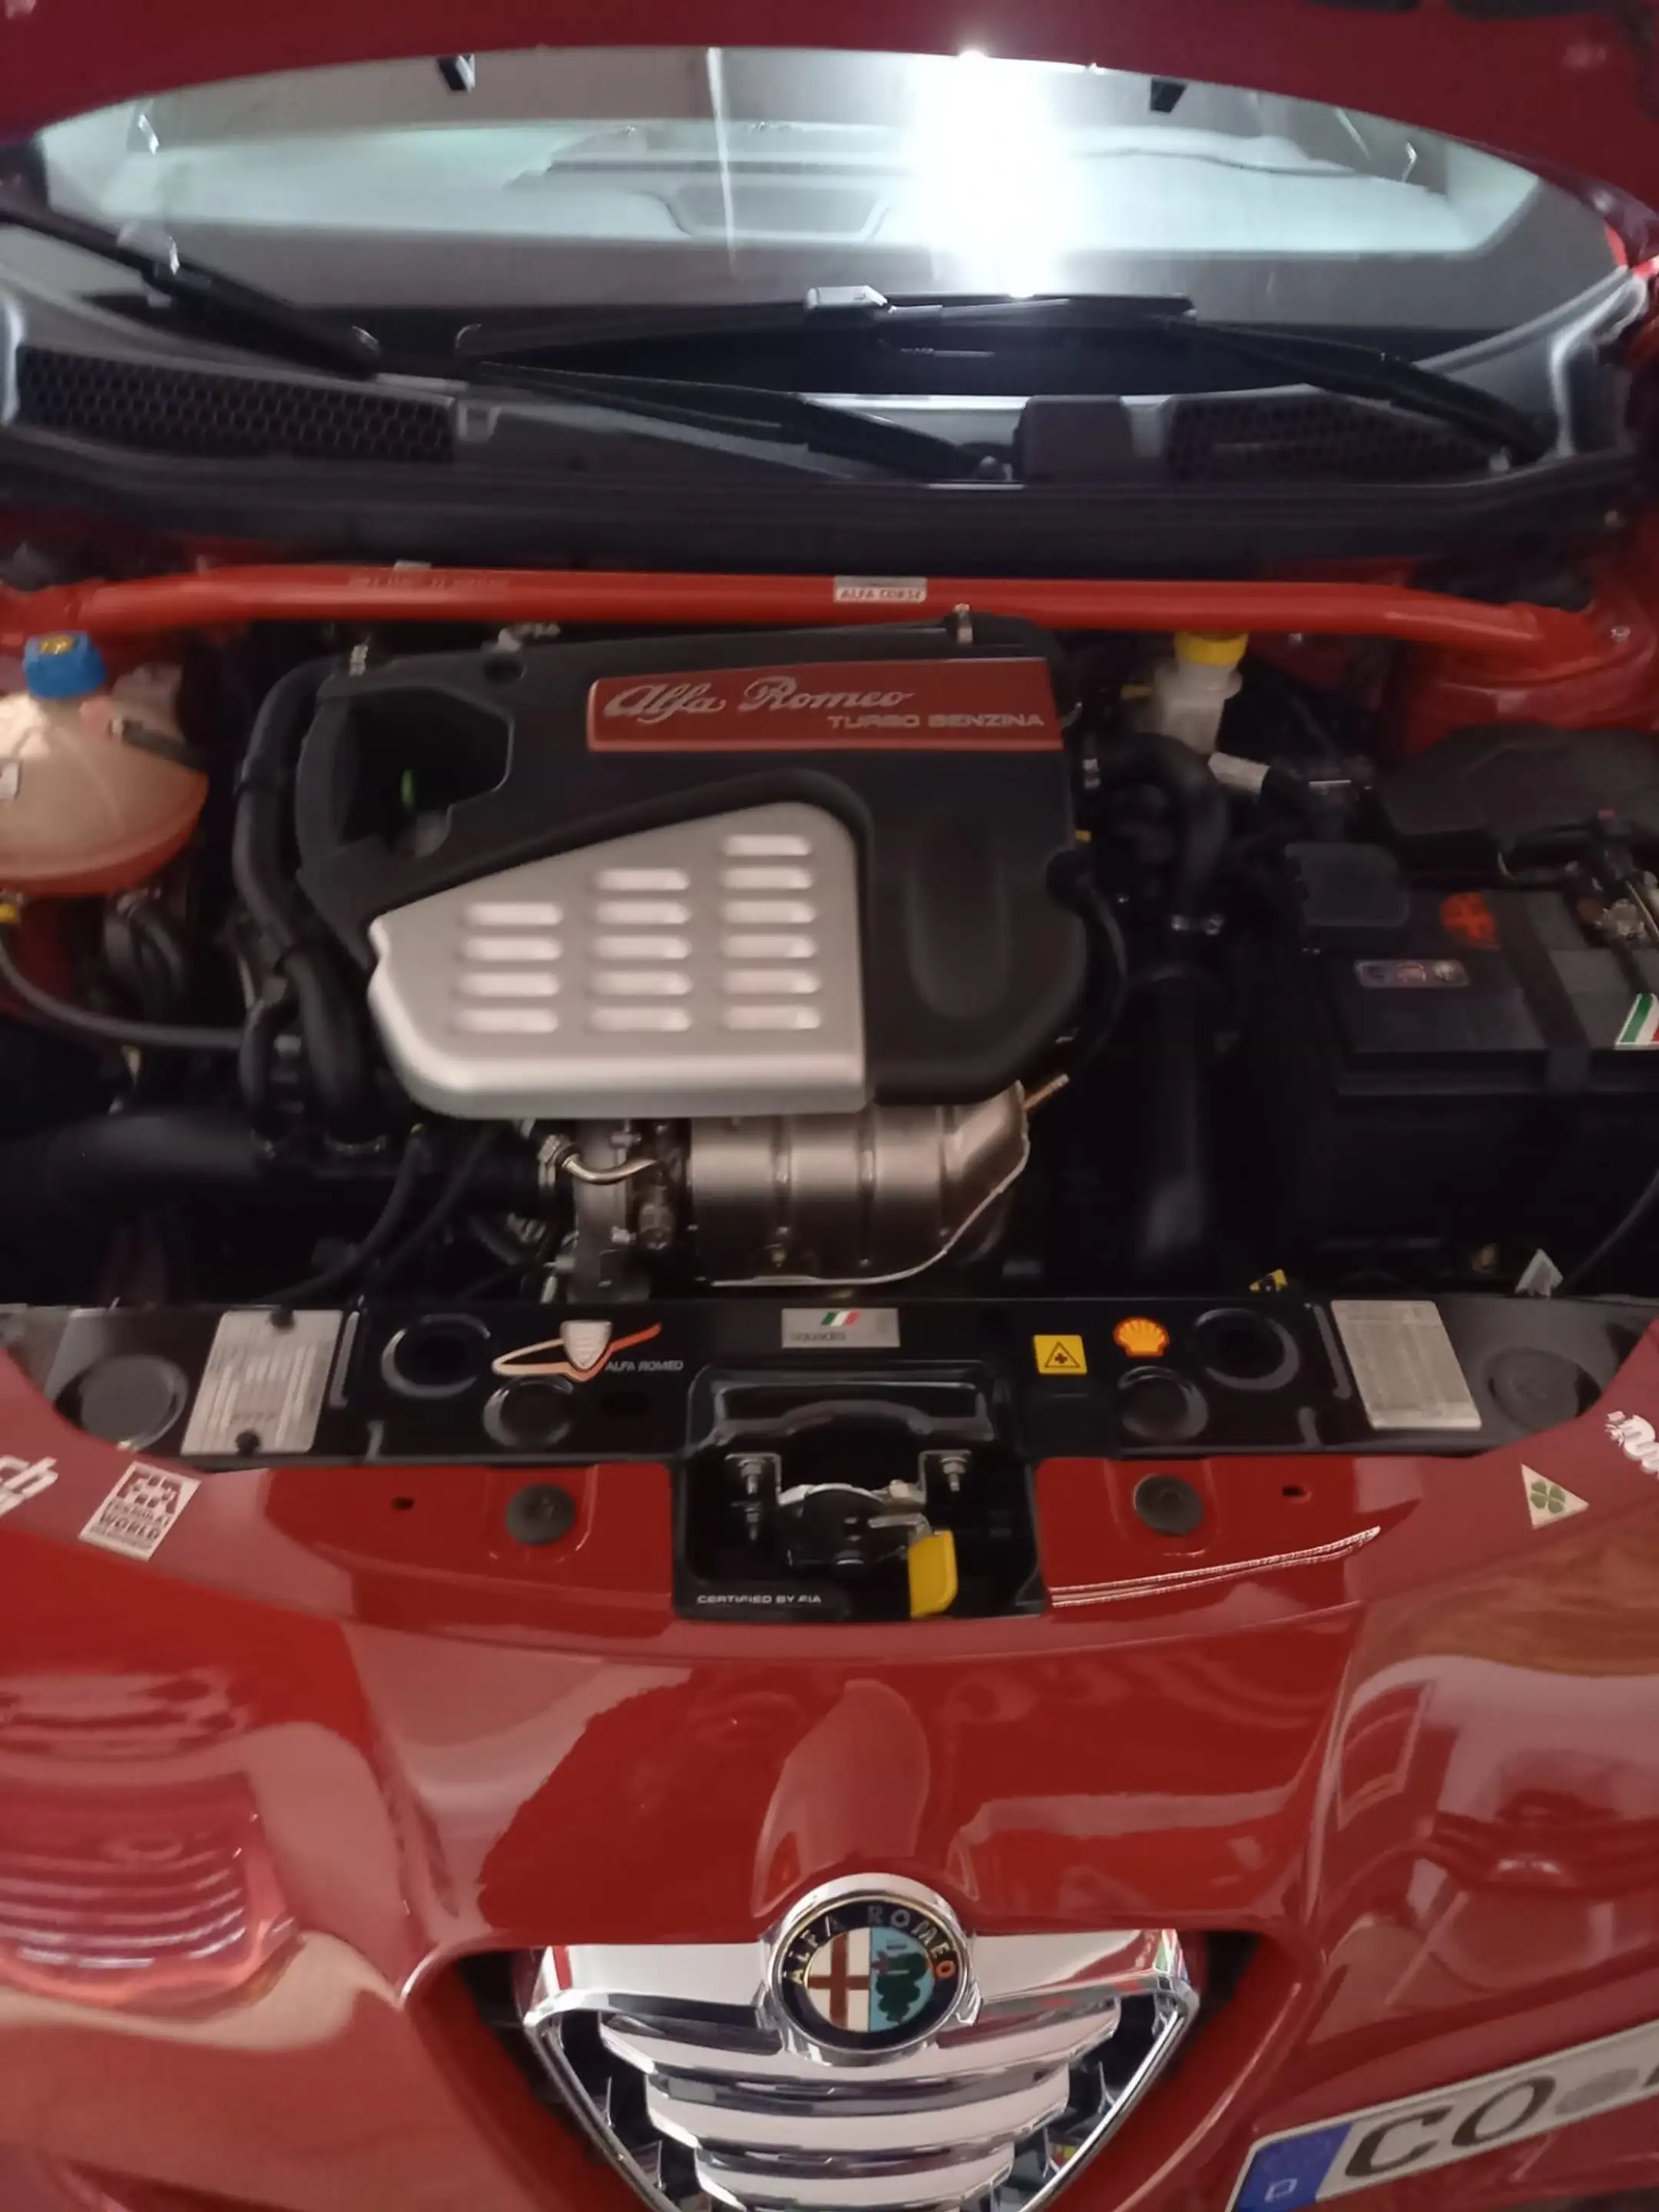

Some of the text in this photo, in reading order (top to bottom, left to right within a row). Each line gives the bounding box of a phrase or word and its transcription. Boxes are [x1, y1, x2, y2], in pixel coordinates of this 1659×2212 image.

[840, 588, 874, 598] ALFA
[604, 676, 915, 724] Alfa Romeo
[827, 714, 1045, 729] TURBO BENZINA
[604, 1359, 684, 1372] ALFA ROMEO
[697, 1594, 773, 1604] CERTIFIED
[775, 1594, 795, 1604] BY
[782, 1905, 957, 1986] ALFA ROMEO
